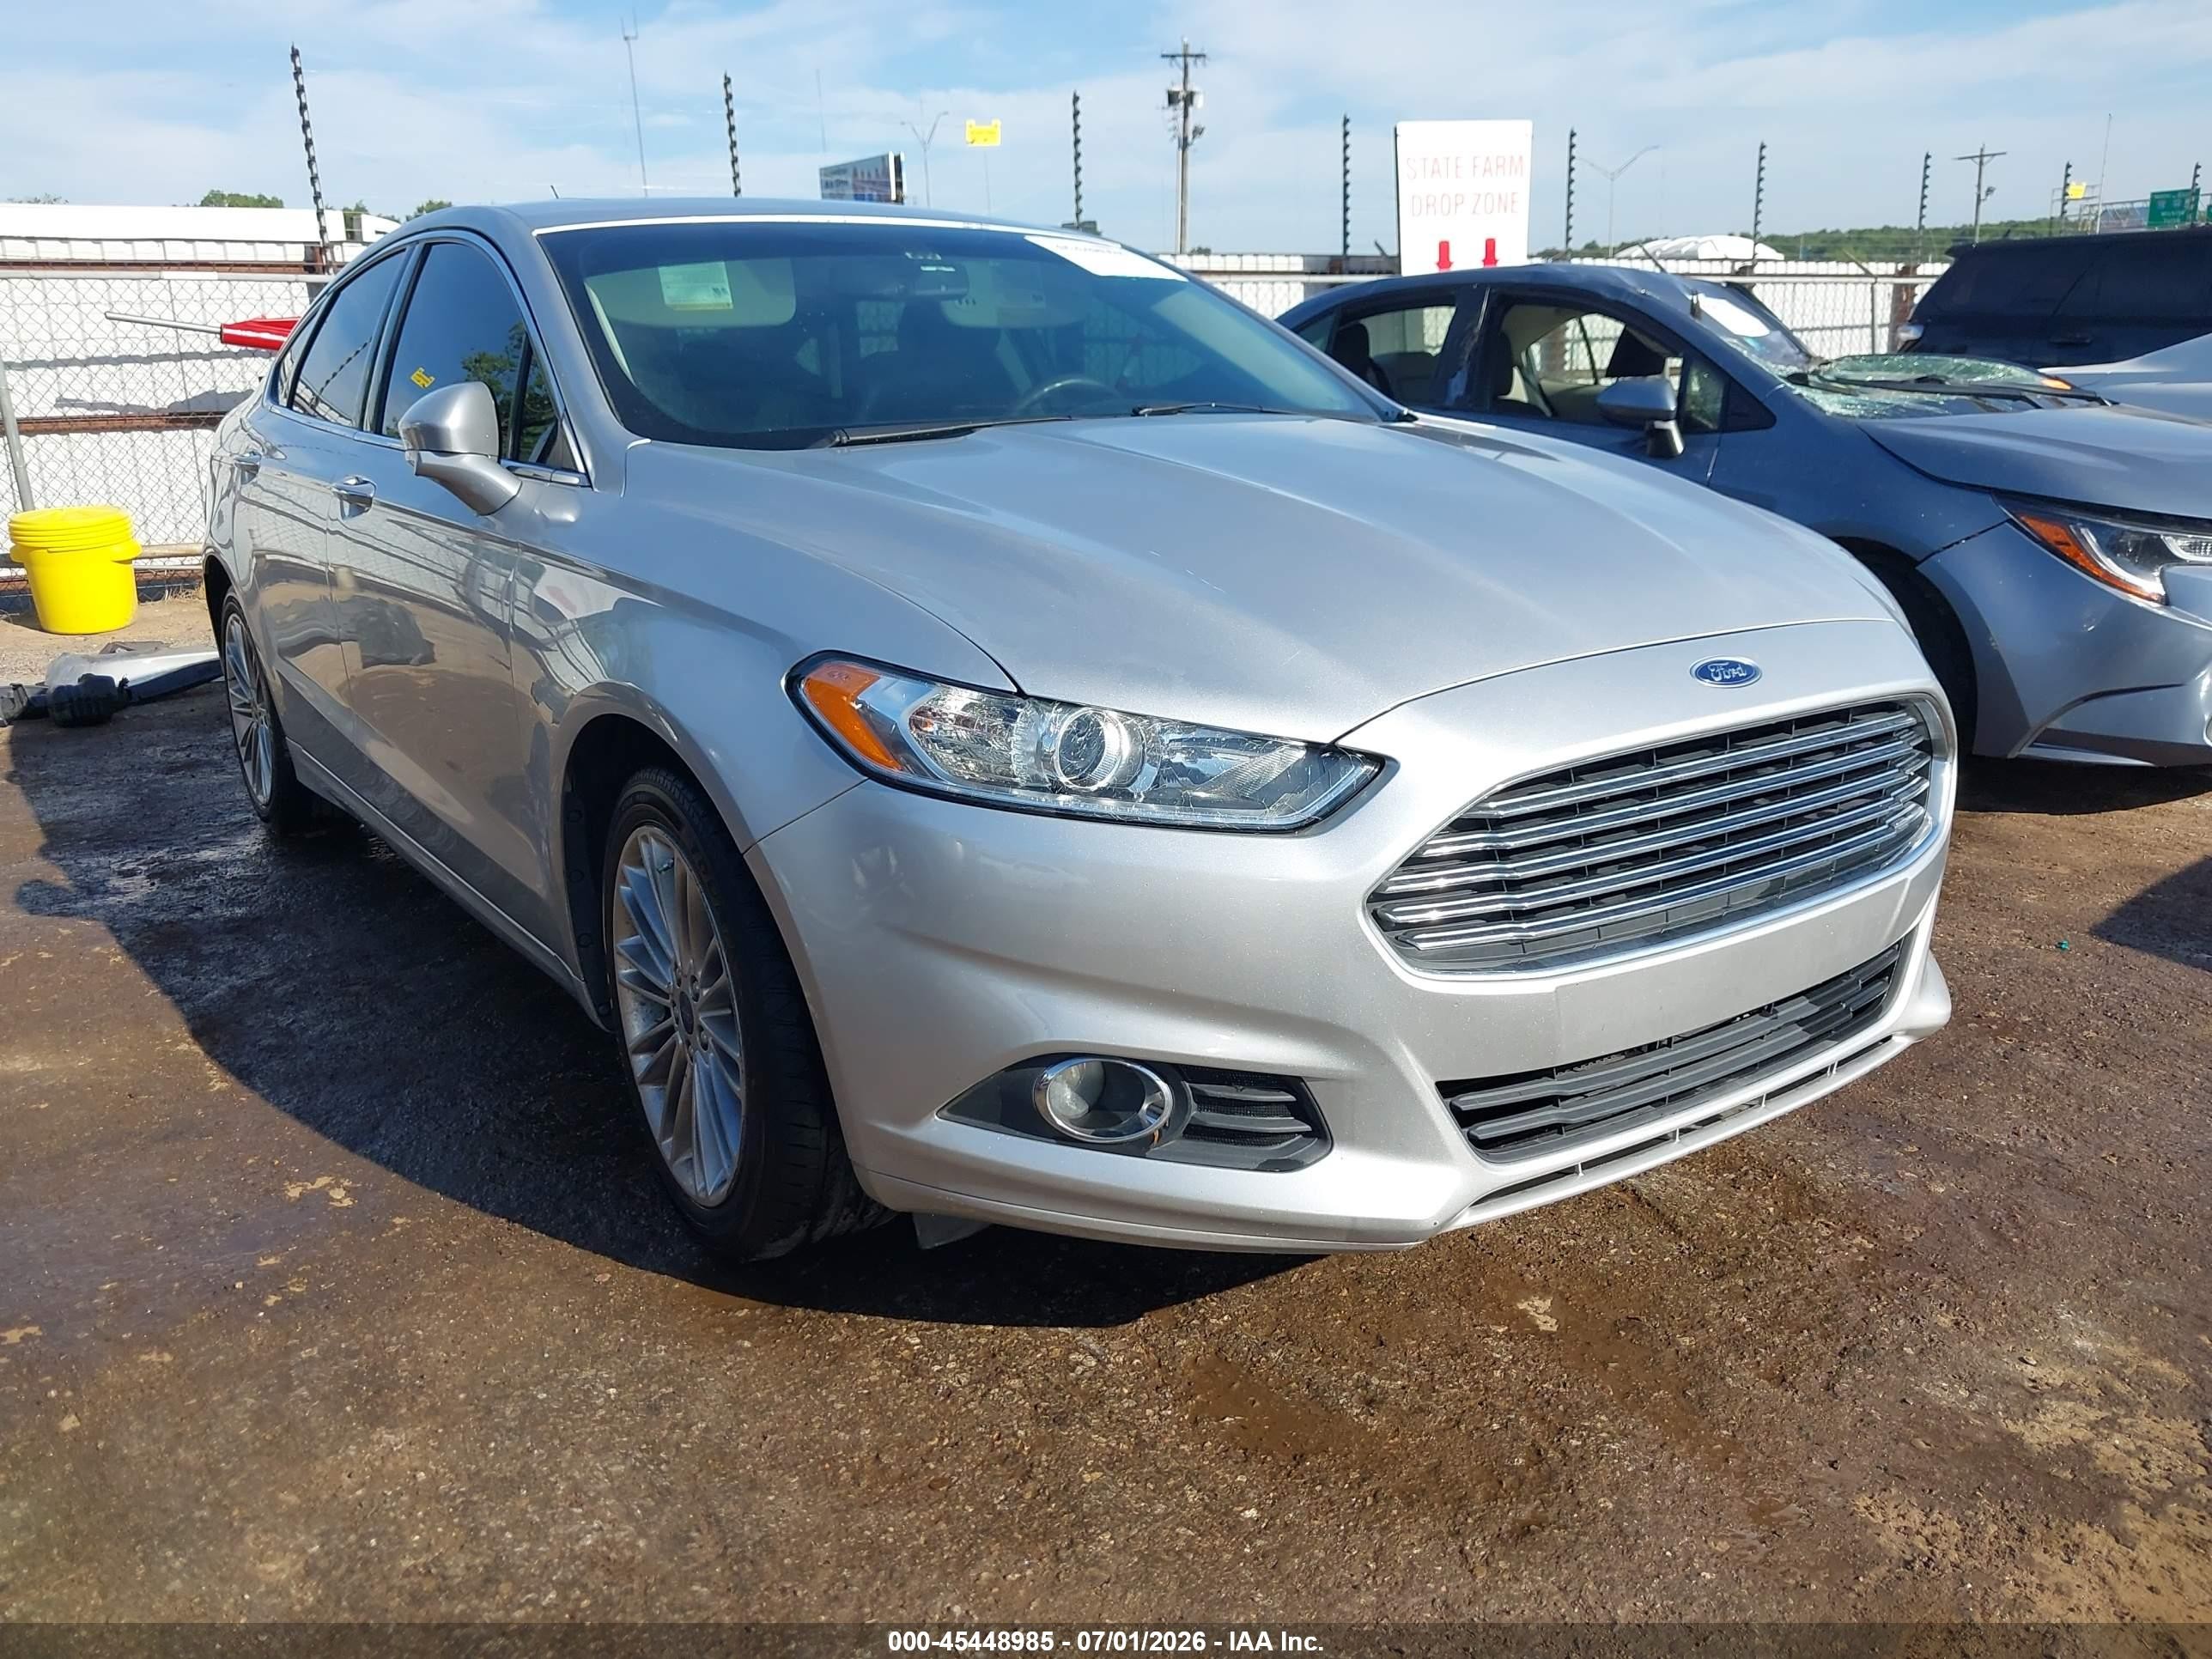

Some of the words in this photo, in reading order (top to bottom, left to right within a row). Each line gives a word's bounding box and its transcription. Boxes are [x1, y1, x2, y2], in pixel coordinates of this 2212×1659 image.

[1407, 157, 1463, 180] STATE
[1472, 155, 1524, 179] FARM
[1411, 192, 1464, 217] DROP
[1472, 191, 1519, 216] ZONE
[1707, 662, 1747, 681] Ford
